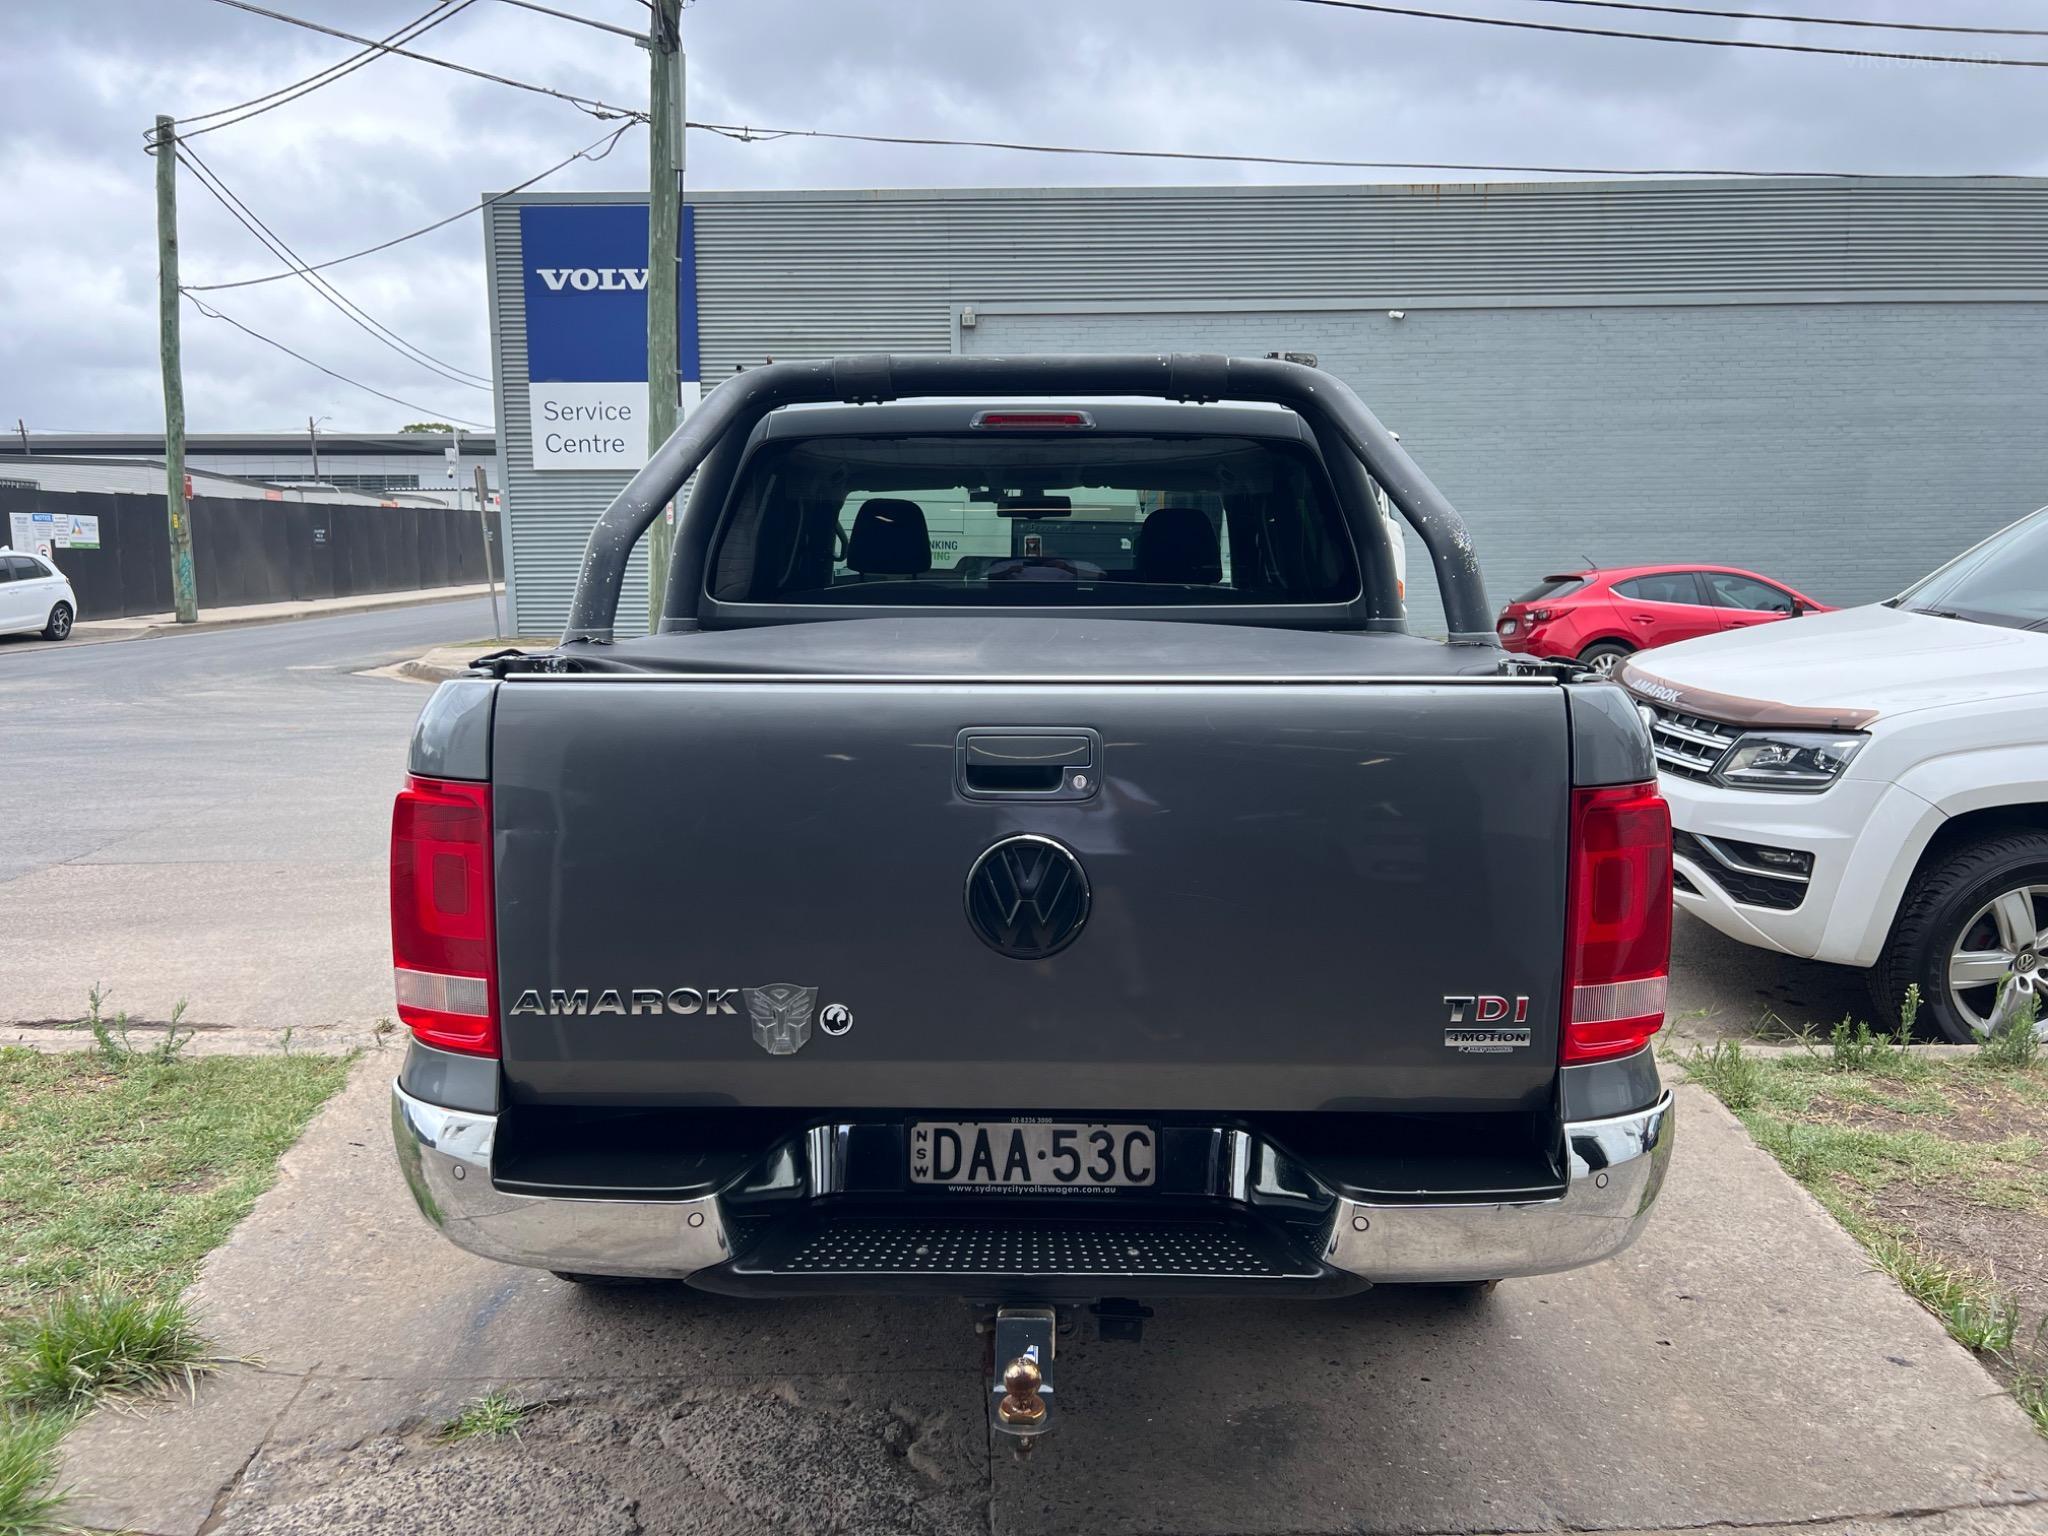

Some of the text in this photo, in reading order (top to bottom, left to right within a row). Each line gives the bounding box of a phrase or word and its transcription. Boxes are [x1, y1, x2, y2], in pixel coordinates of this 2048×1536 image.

[536, 268, 649, 291] VOLV
[544, 401, 632, 421] Service
[545, 433, 625, 453] Centre
[1630, 679, 1683, 702] AMAROK
[509, 987, 739, 1016] AMAROK
[1443, 995, 1530, 1022] TDI
[1449, 1032, 1527, 1042] 4MOTION
[948, 1184, 1117, 1194] www.sydneycityvolkswagen.com.au
